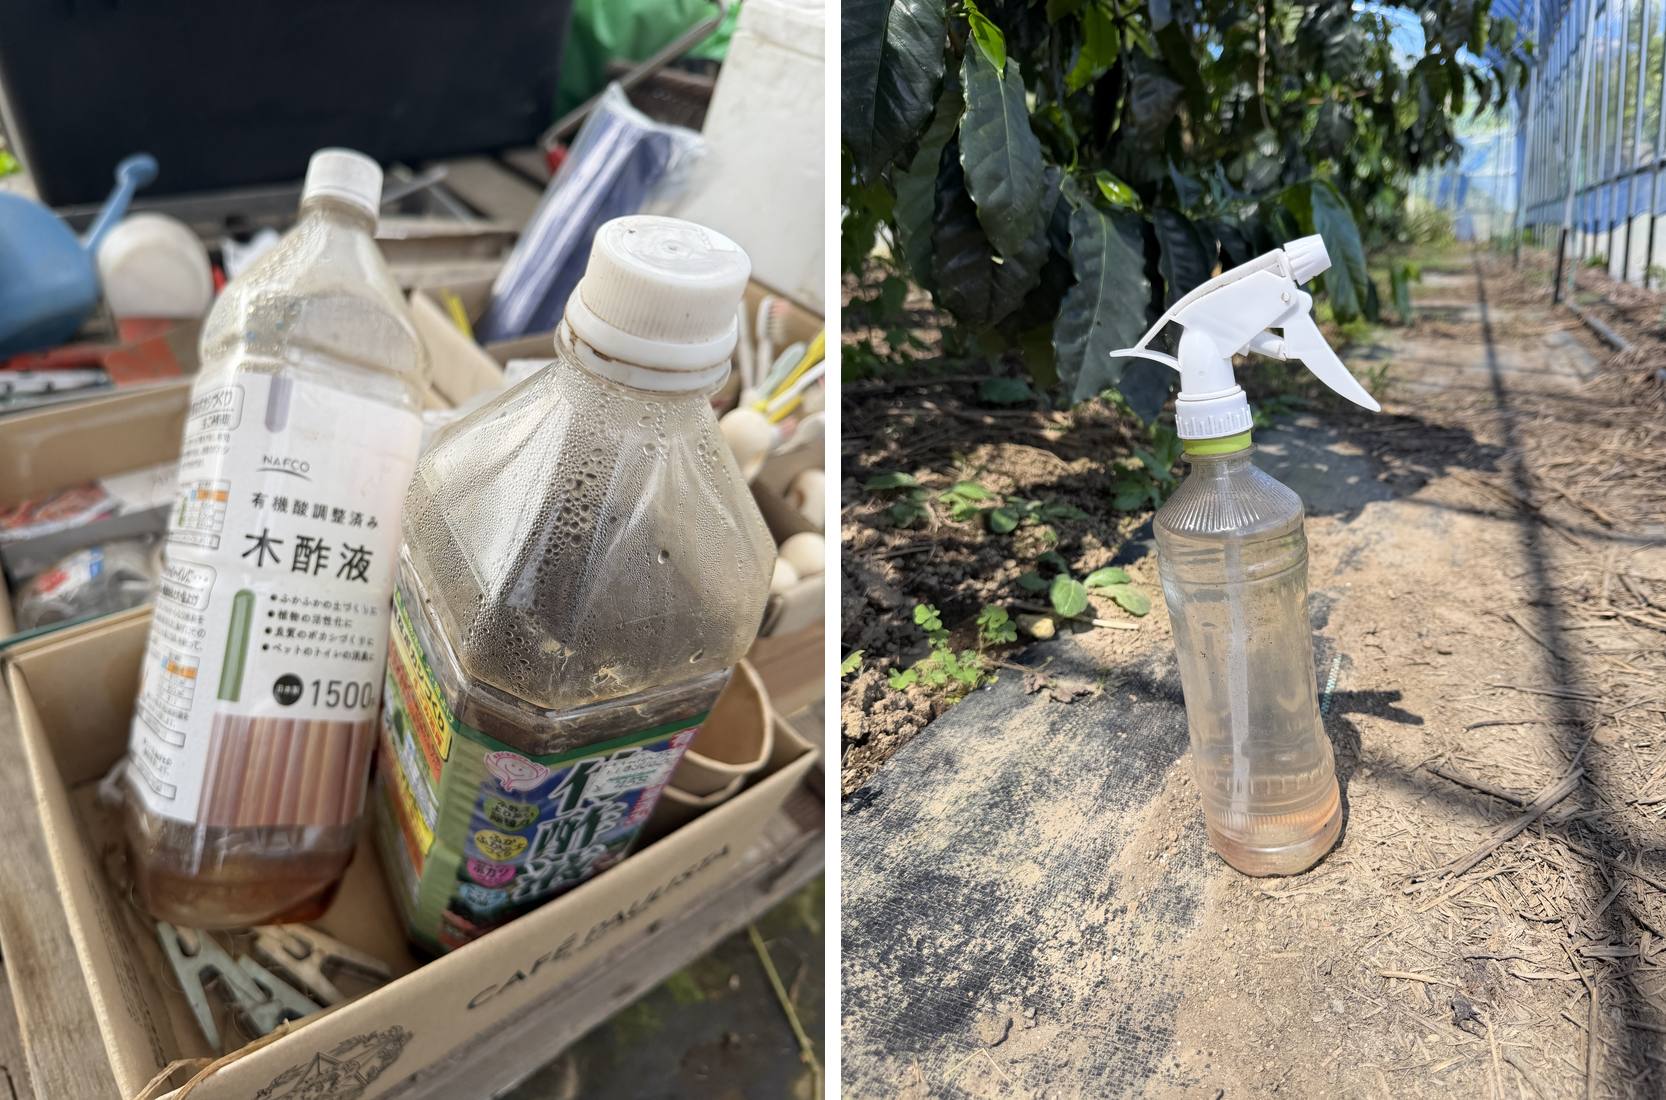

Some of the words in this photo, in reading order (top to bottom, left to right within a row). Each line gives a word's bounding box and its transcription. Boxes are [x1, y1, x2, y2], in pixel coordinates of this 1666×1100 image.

[262, 454, 311, 473] NAFCO
[251, 491, 378, 530] 有機酸調整済み
[242, 528, 374, 583] 木酢液
